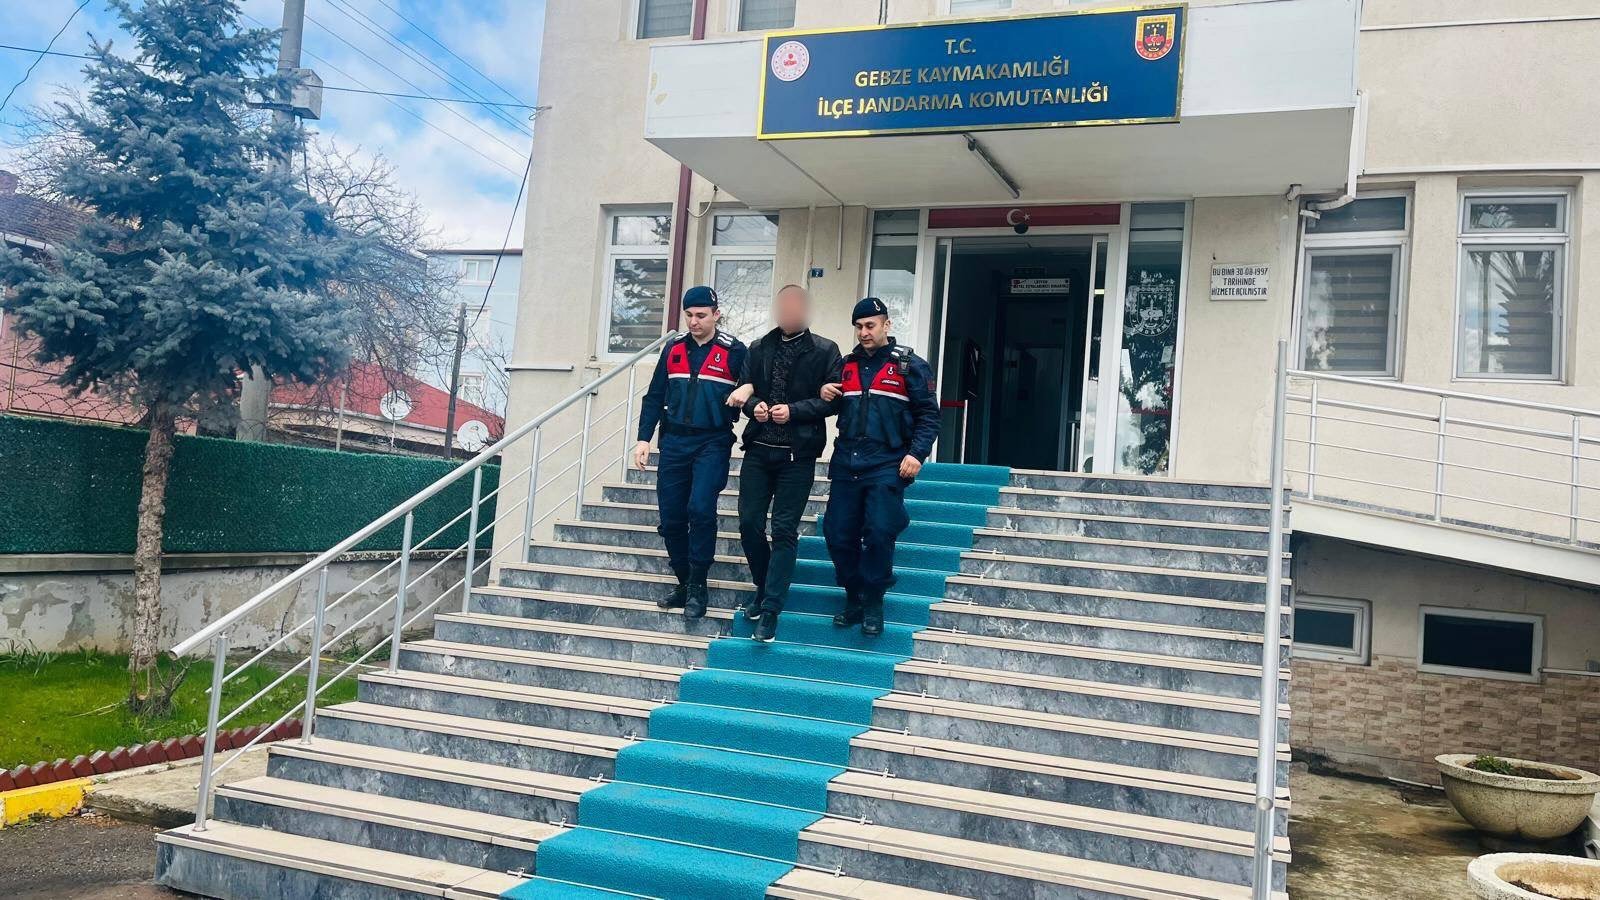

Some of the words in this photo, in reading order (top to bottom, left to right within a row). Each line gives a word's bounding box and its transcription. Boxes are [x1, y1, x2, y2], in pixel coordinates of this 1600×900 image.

[944, 38, 977, 55] T.C.
[855, 69, 912, 87] GEBZE
[917, 55, 1070, 83] KAYMAKAMLIĞI
[818, 97, 854, 119] İLÇE
[857, 93, 963, 114] JANDARMA
[969, 81, 1109, 108] KOMUTANLIĞI
[1212, 268, 1221, 276] BU
